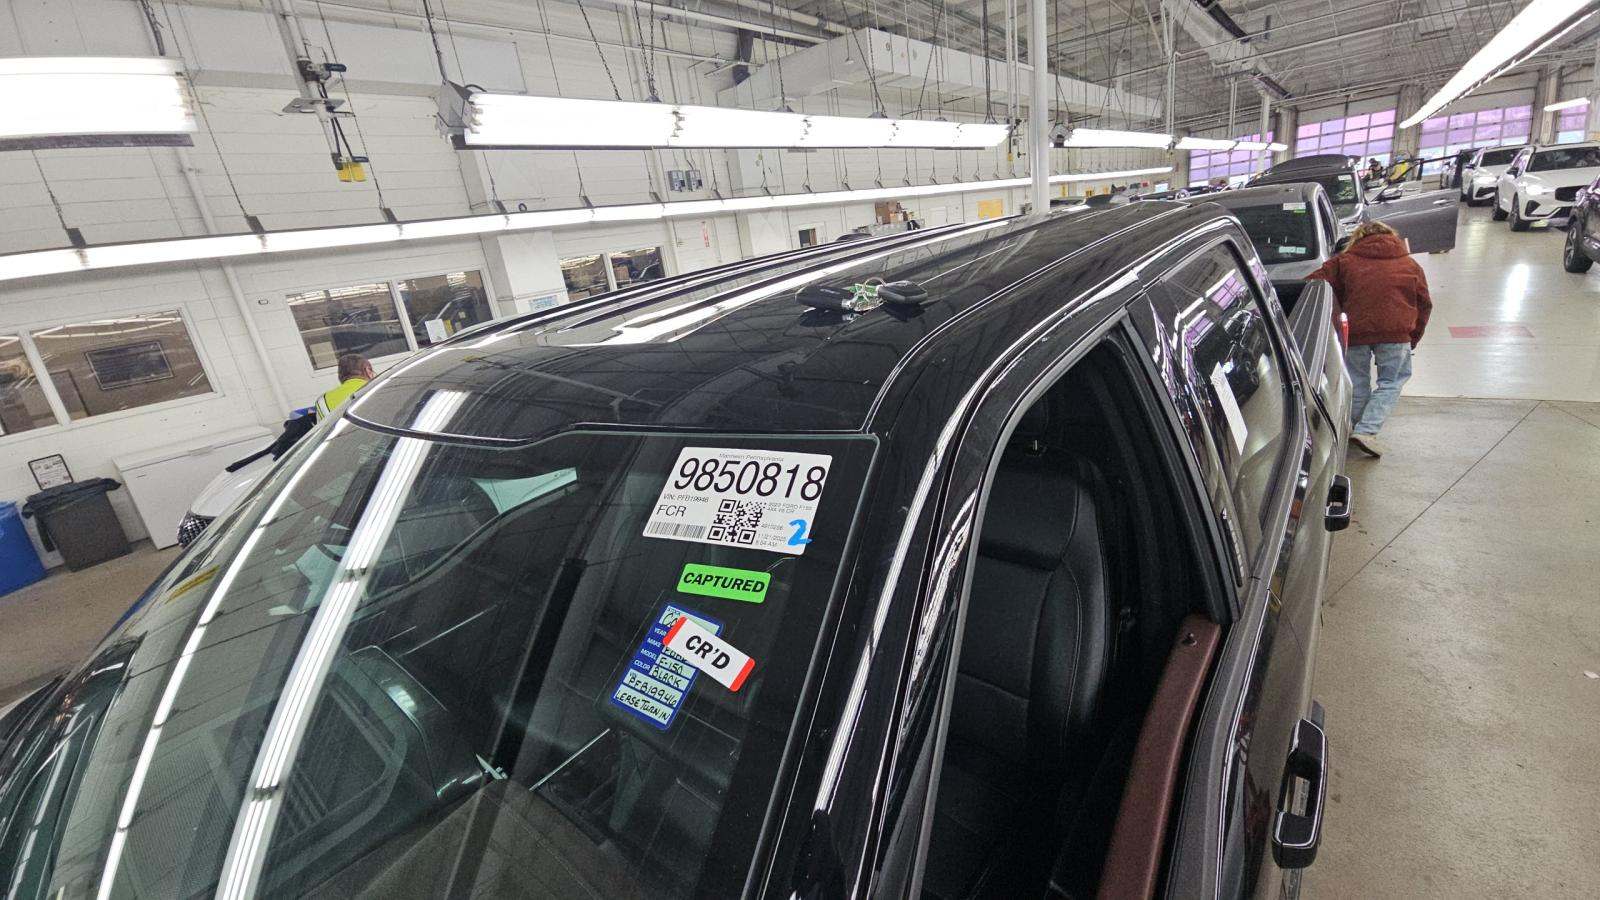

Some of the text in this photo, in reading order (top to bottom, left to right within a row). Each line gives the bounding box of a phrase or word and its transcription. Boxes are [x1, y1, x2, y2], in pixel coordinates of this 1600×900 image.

[674, 457, 826, 501] 9850818
[656, 504, 687, 517] FCR
[788, 519, 814, 545] 2
[683, 572, 766, 593] CAPTURED
[640, 648, 658, 660] MODEL
[685, 634, 731, 670] CR'D
[634, 659, 651, 671] COLOR
[653, 666, 682, 688] BLACK
[615, 690, 641, 708] LEASE
[628, 676, 677, 706] PFB19946
